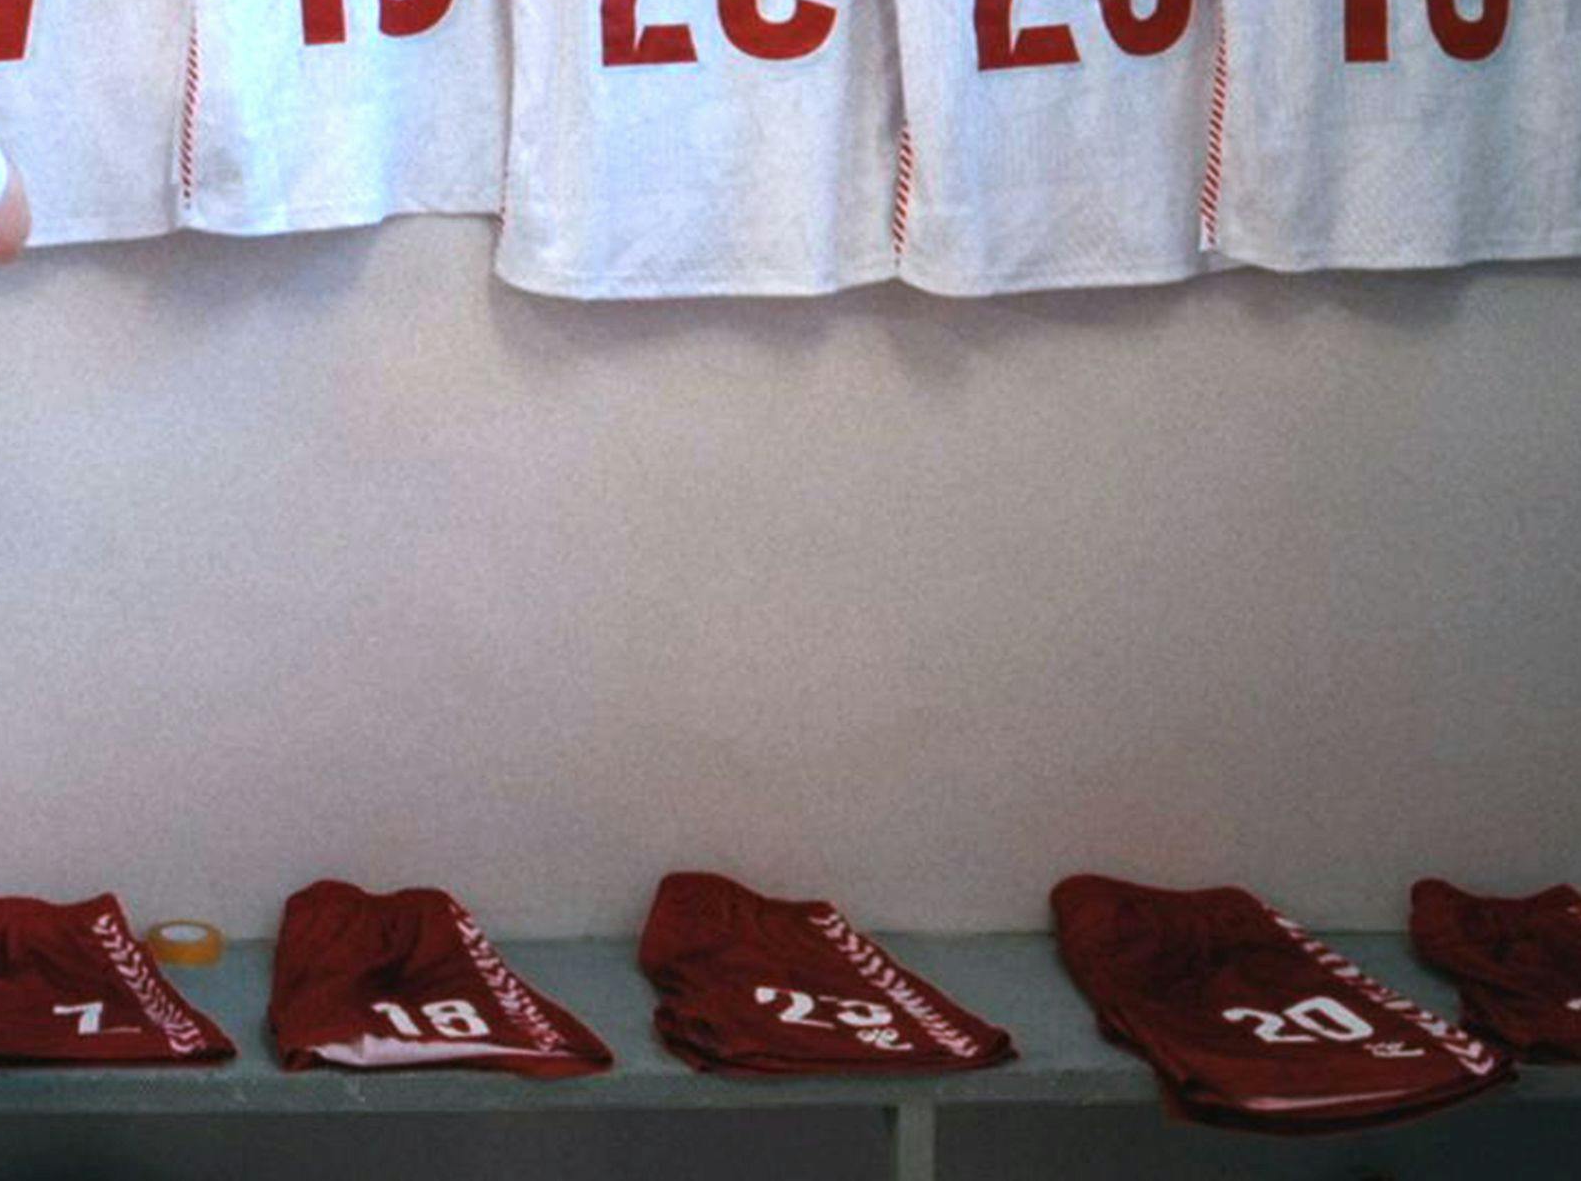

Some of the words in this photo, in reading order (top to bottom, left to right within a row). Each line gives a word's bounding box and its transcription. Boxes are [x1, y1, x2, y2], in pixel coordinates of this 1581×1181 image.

[52, 1000, 104, 1035] 7
[370, 999, 491, 1038] 18
[1222, 995, 1374, 1041] 20
